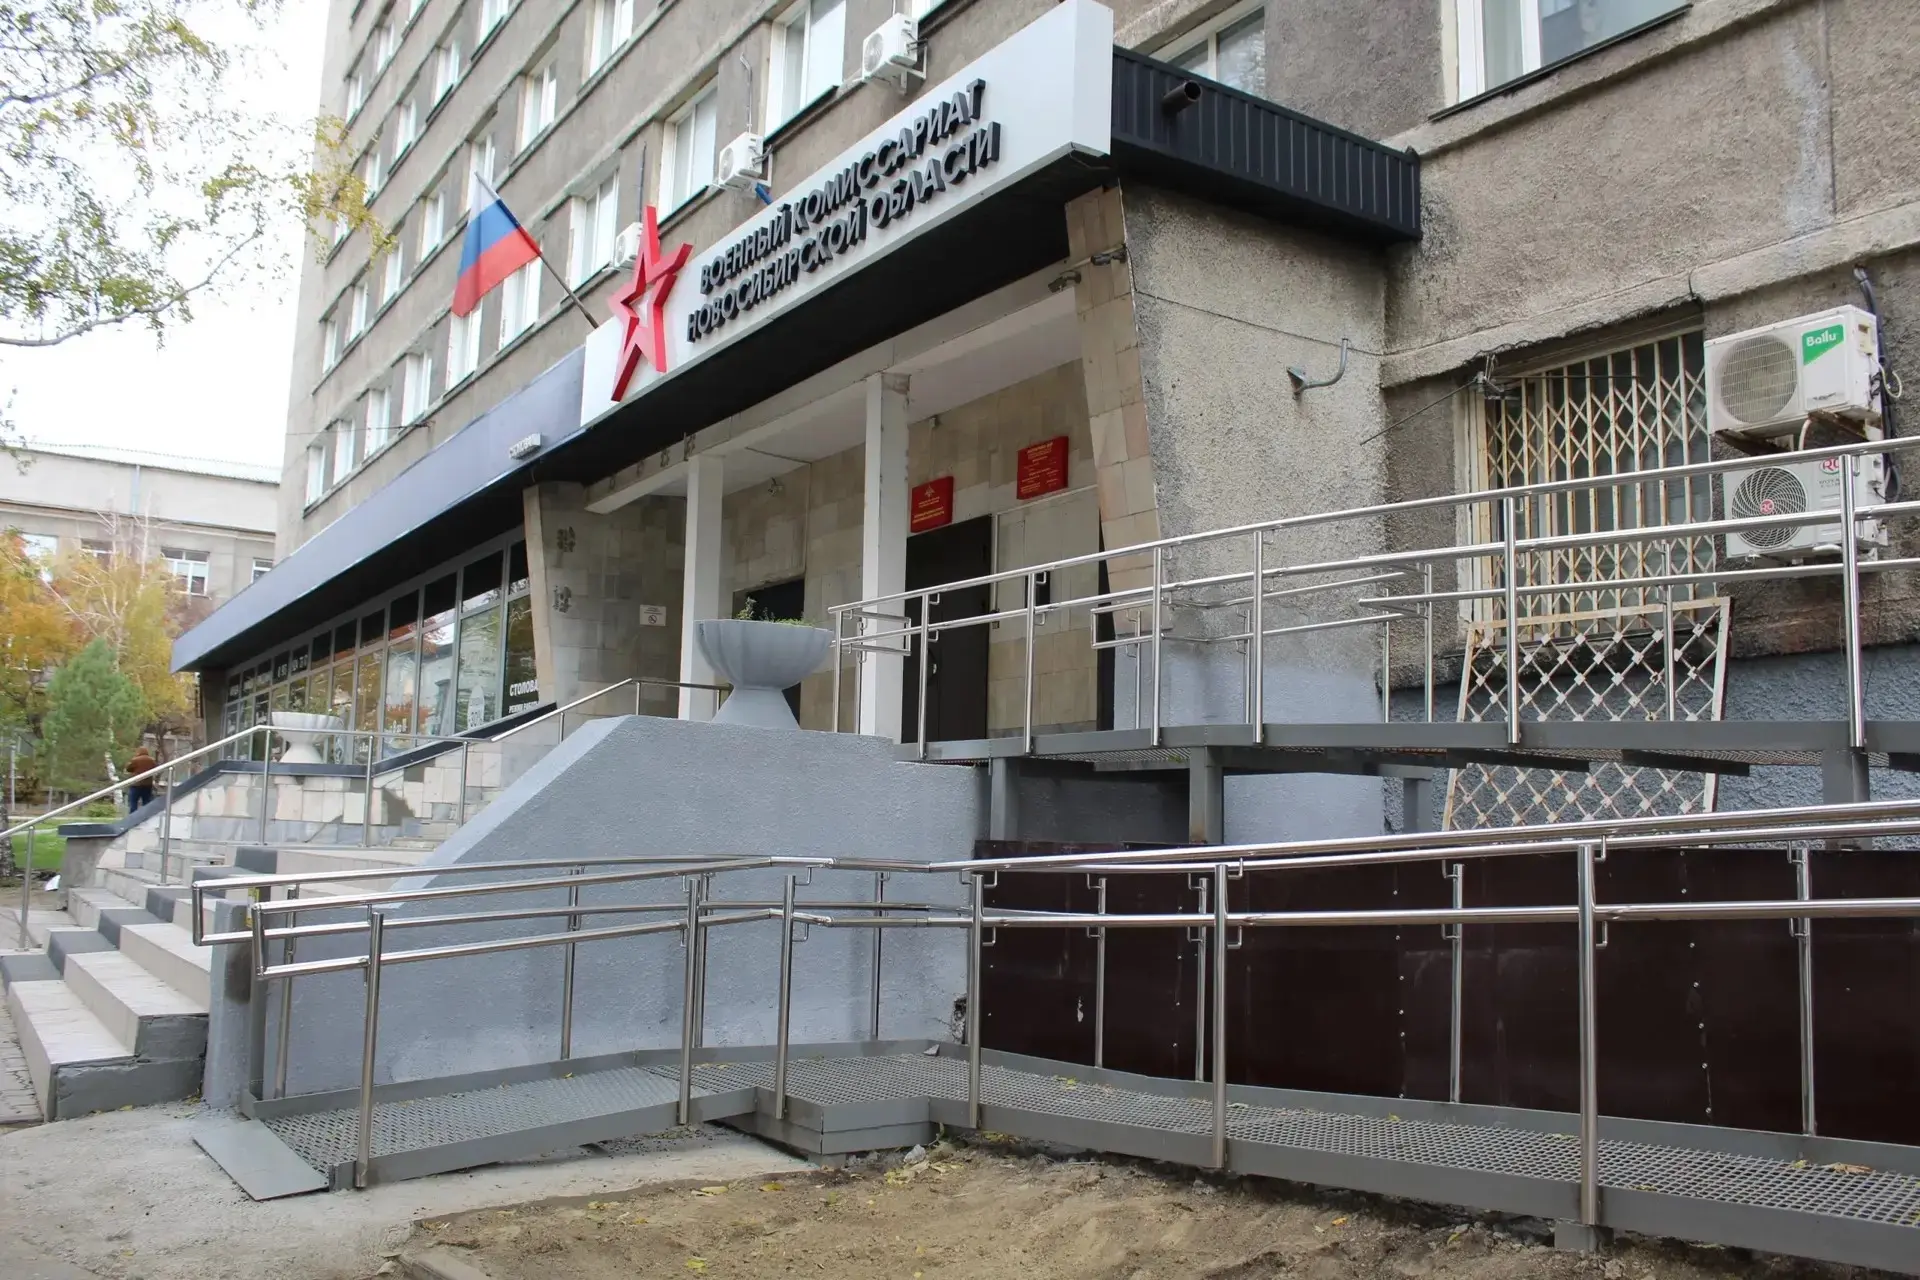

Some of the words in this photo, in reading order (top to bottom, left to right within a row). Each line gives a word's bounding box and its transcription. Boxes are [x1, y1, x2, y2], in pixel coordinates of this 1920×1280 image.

[687, 197, 867, 343] НОВОСИБИРСКОЙ
[868, 121, 1002, 229] ОБЛАСТИ
[700, 203, 791, 295] ВОЕННЫЙ
[791, 78, 986, 235] КОМИССАРИАТ
[1806, 330, 1837, 347] Ballu
